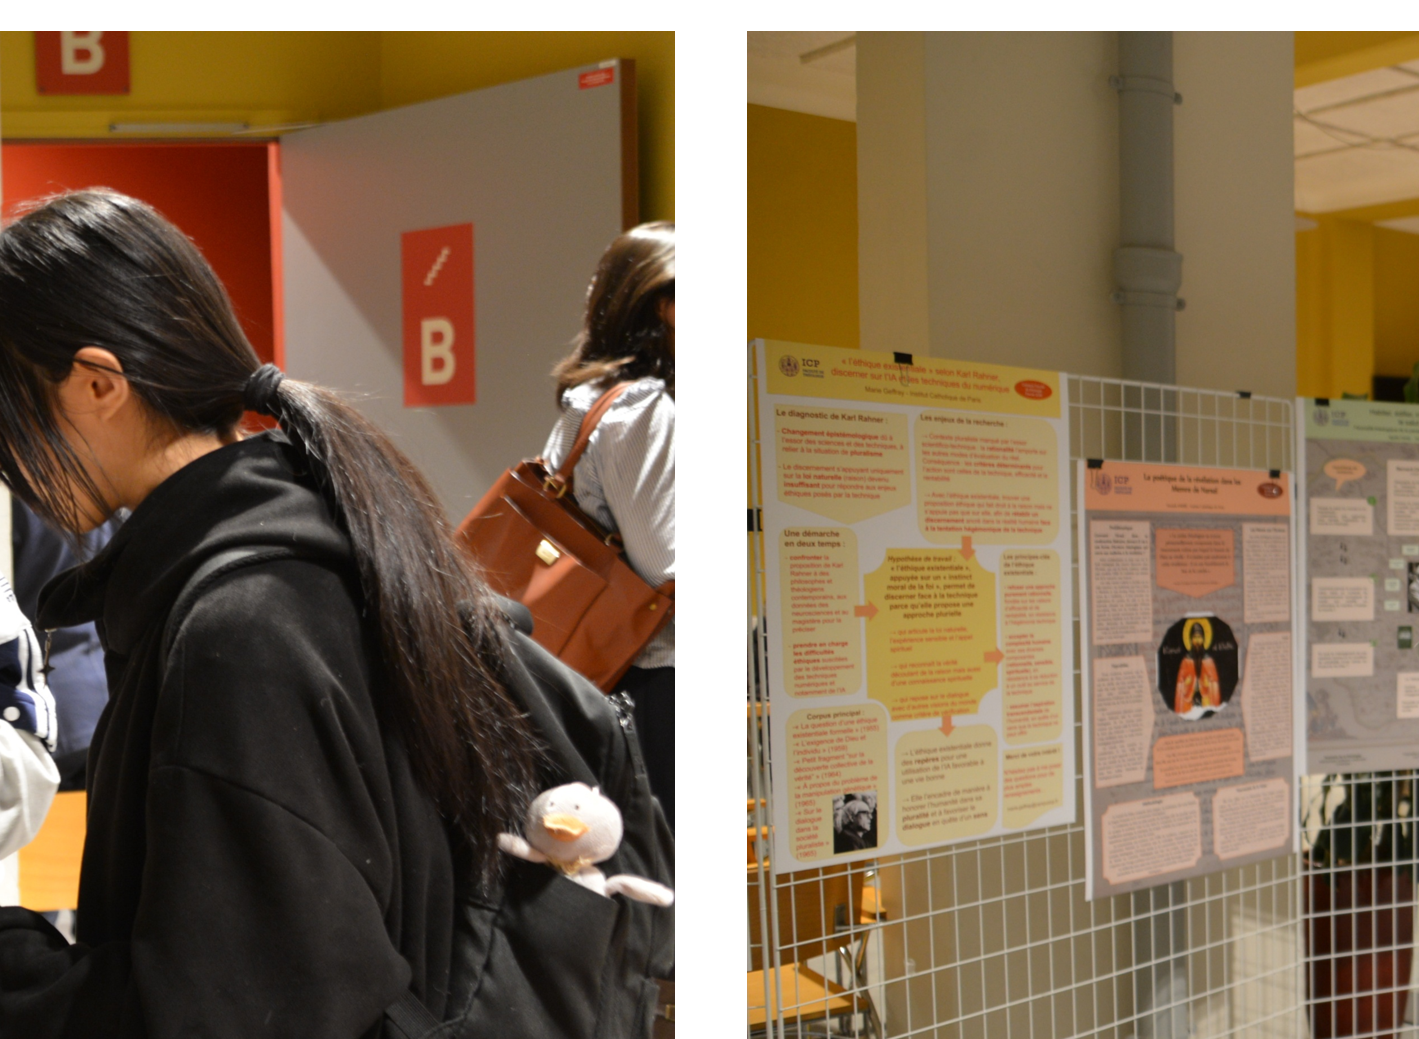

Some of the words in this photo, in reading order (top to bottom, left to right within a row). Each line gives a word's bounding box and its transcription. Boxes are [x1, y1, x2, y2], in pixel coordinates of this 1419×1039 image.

[61, 31, 105, 75] B
[421, 318, 456, 386] B
[802, 358, 820, 367] ICP
[776, 408, 786, 417] Le
[788, 409, 829, 420] diagnostic
[830, 412, 840, 420] de
[841, 413, 856, 421] Karl
[858, 415, 884, 424] Rahner
[784, 529, 800, 538] Une
[802, 529, 840, 538] démarche
[796, 540, 816, 548] deux
[817, 540, 842, 549] temps
[806, 711, 832, 720] Corpus
